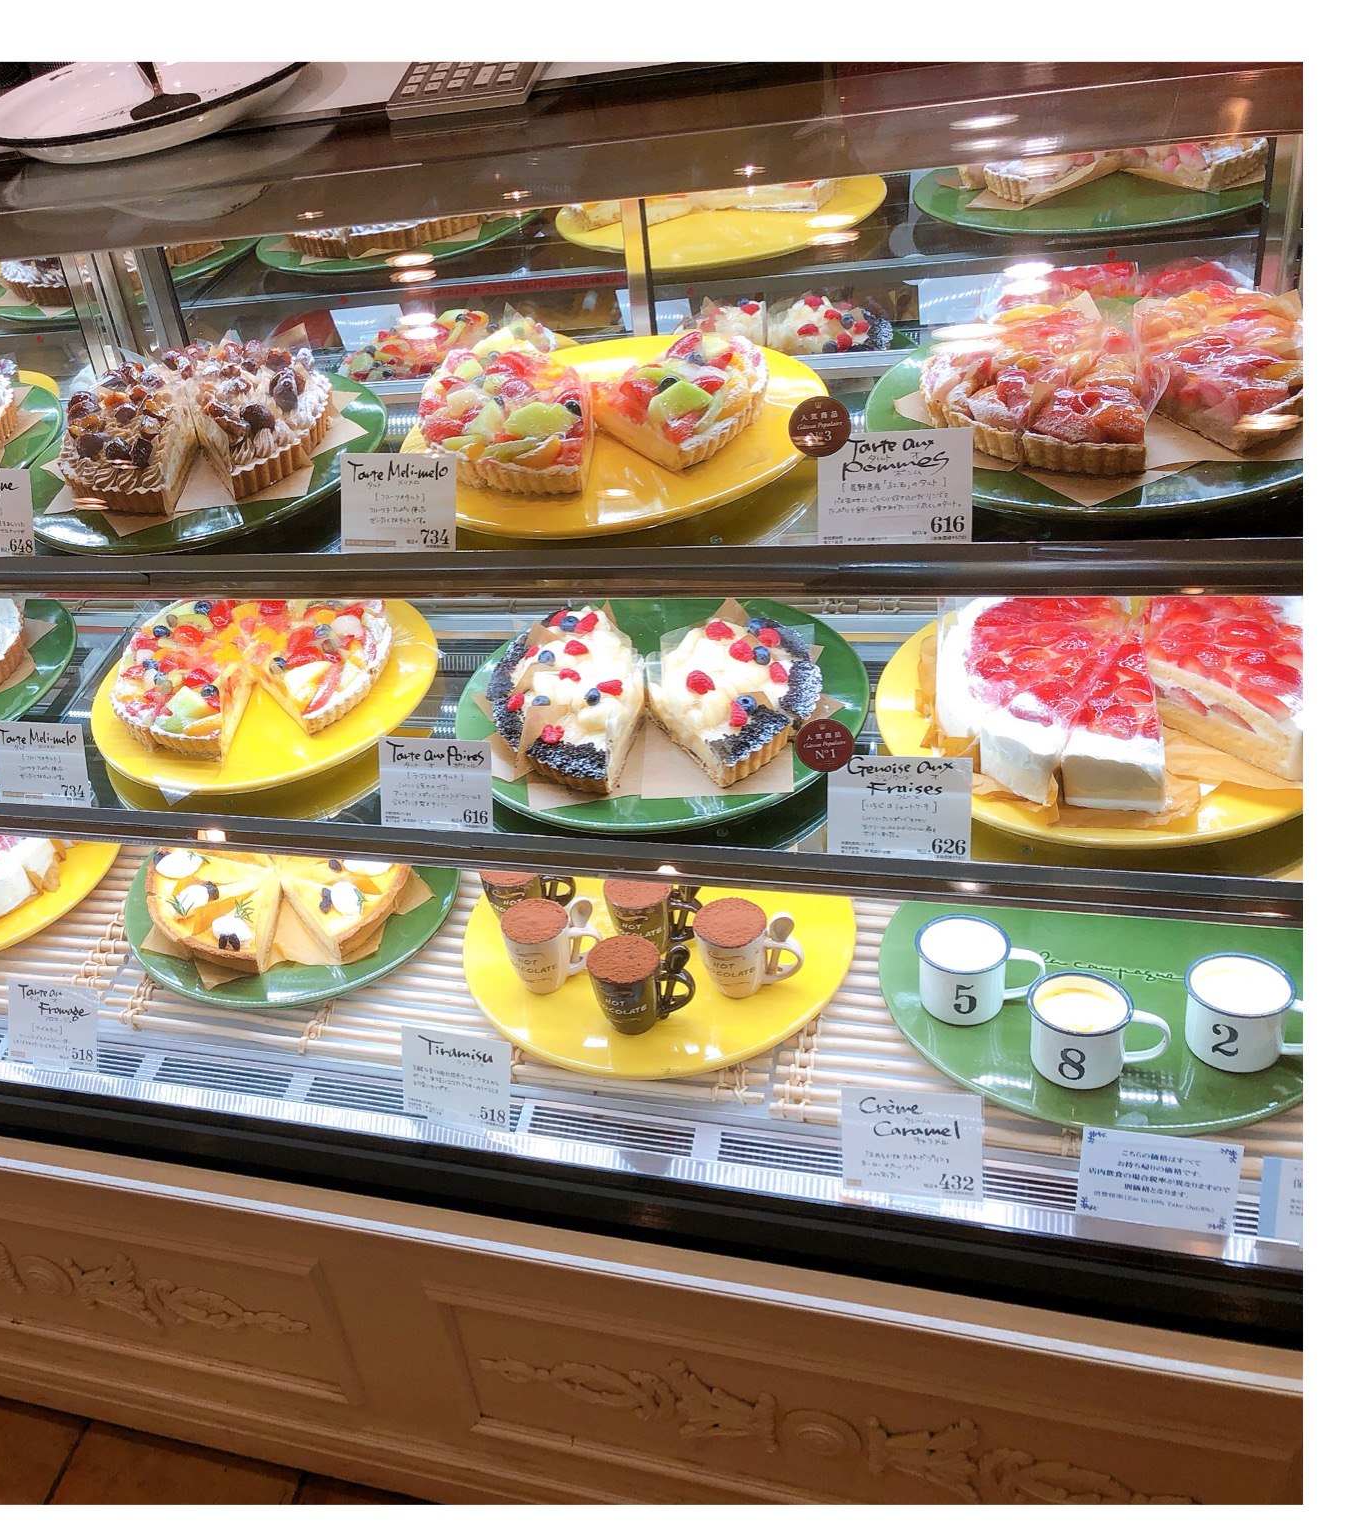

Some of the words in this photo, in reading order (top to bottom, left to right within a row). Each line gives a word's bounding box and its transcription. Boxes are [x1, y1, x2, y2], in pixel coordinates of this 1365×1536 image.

[931, 515, 965, 533] 616
[420, 529, 449, 545] 734
[10, 539, 33, 553] 648
[463, 809, 488, 824] 616
[931, 838, 966, 855] 626
[953, 984, 977, 1014] 5
[1211, 1023, 1239, 1058] 2
[72, 1047, 93, 1061] 518
[1057, 1048, 1087, 1081] 8
[480, 1106, 506, 1124] 518
[939, 1174, 974, 1191] 432
